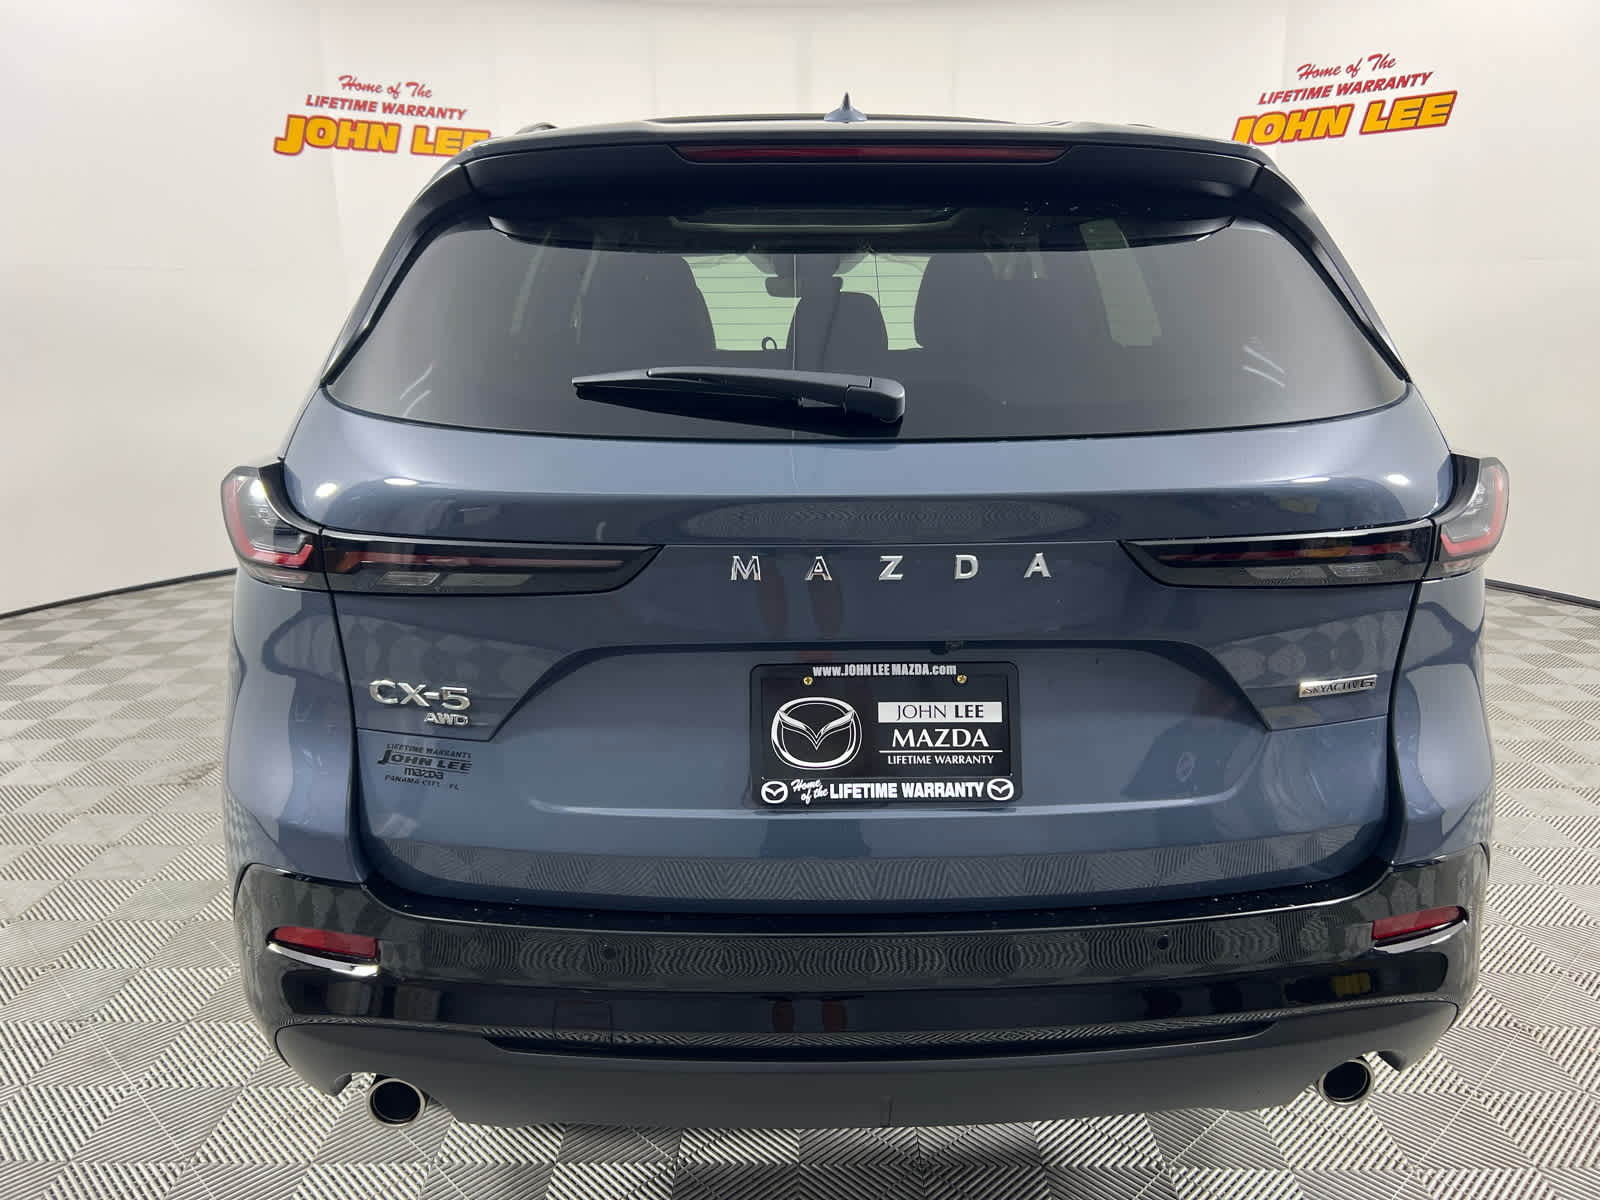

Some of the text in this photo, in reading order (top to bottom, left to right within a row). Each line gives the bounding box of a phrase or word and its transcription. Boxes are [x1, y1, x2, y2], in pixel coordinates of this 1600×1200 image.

[1296, 52, 1396, 81] Home of The
[338, 74, 433, 101] Home of The
[1257, 71, 1433, 105] LIFETIME WARRANTY
[305, 94, 467, 121] LIFETIME WARRANTY
[1359, 91, 1458, 135] LEE
[273, 114, 402, 156] JOHN
[730, 552, 1052, 582] MAZDA
[369, 680, 471, 711] CX-5
[423, 712, 469, 726] AWD
[896, 704, 984, 719] JOHN LEE
[892, 728, 989, 748] MAZDA
[376, 749, 473, 771] JOHN LEE
[385, 743, 472, 759] LIFETIME WARRANTY
[887, 754, 994, 765] LIFETIME WARRANTY
[791, 778, 822, 793] Home
[800, 784, 829, 805] of the
[829, 781, 985, 799] LIFETIME WARRANTY
